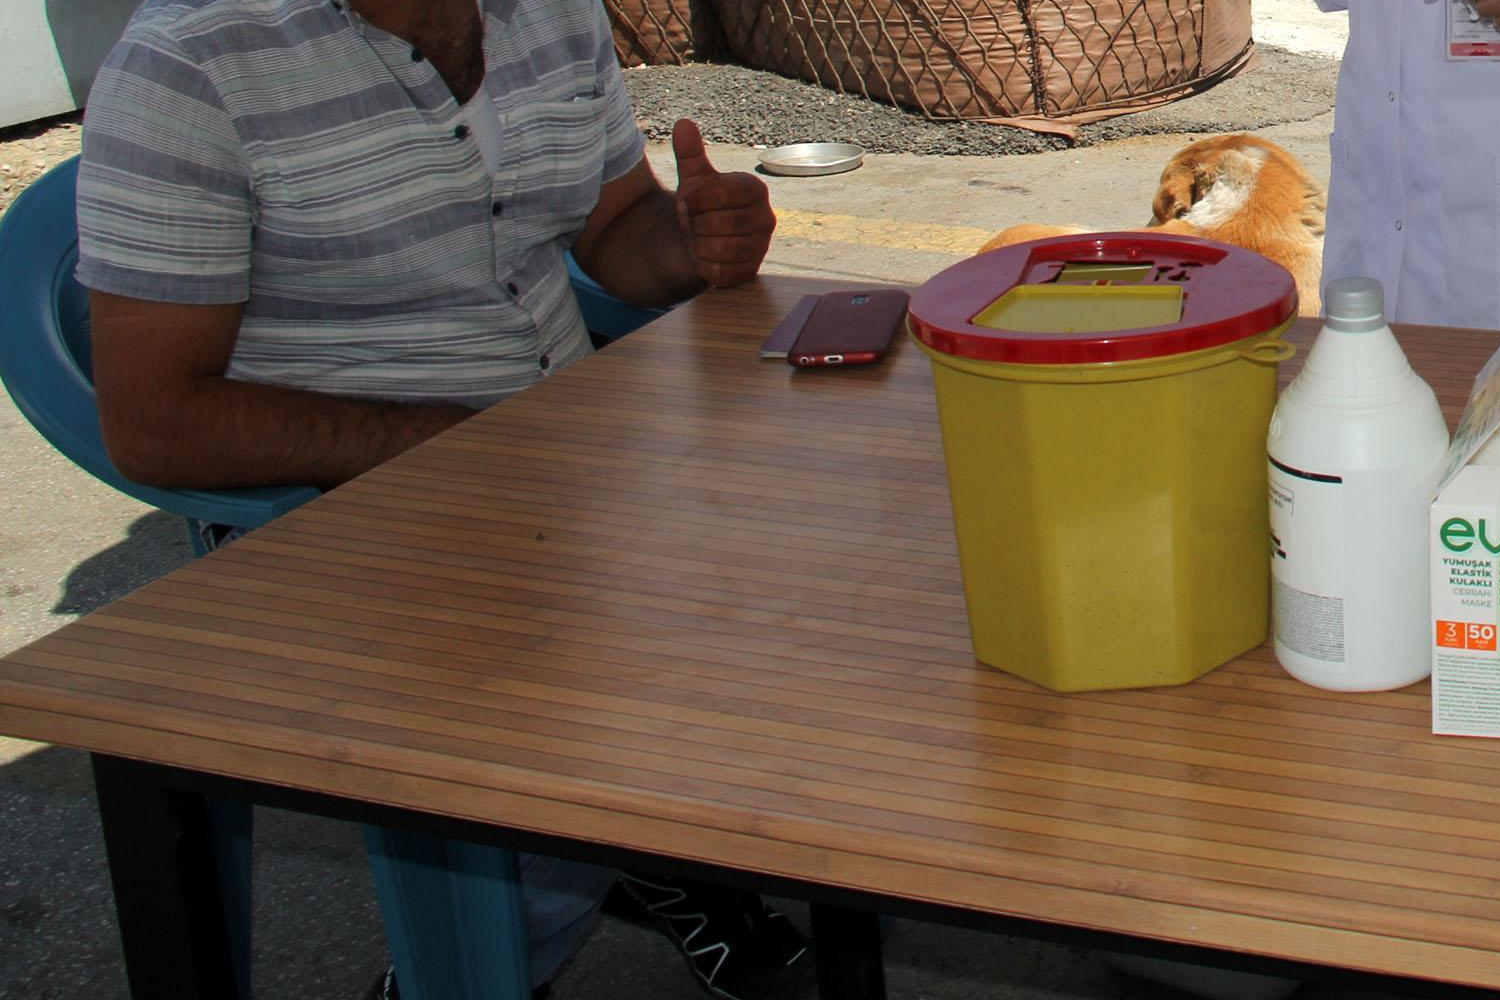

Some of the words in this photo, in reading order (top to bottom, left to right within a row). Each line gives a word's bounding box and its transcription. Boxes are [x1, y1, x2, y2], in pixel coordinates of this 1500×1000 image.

[1443, 558, 1492, 568] YUMUŞAK
[1451, 568, 1492, 577] ELASTİK
[1449, 578, 1492, 587] KULAKLI
[1461, 599, 1492, 608] MASKE
[1446, 622, 1456, 637] 3
[1469, 624, 1494, 640] 50
